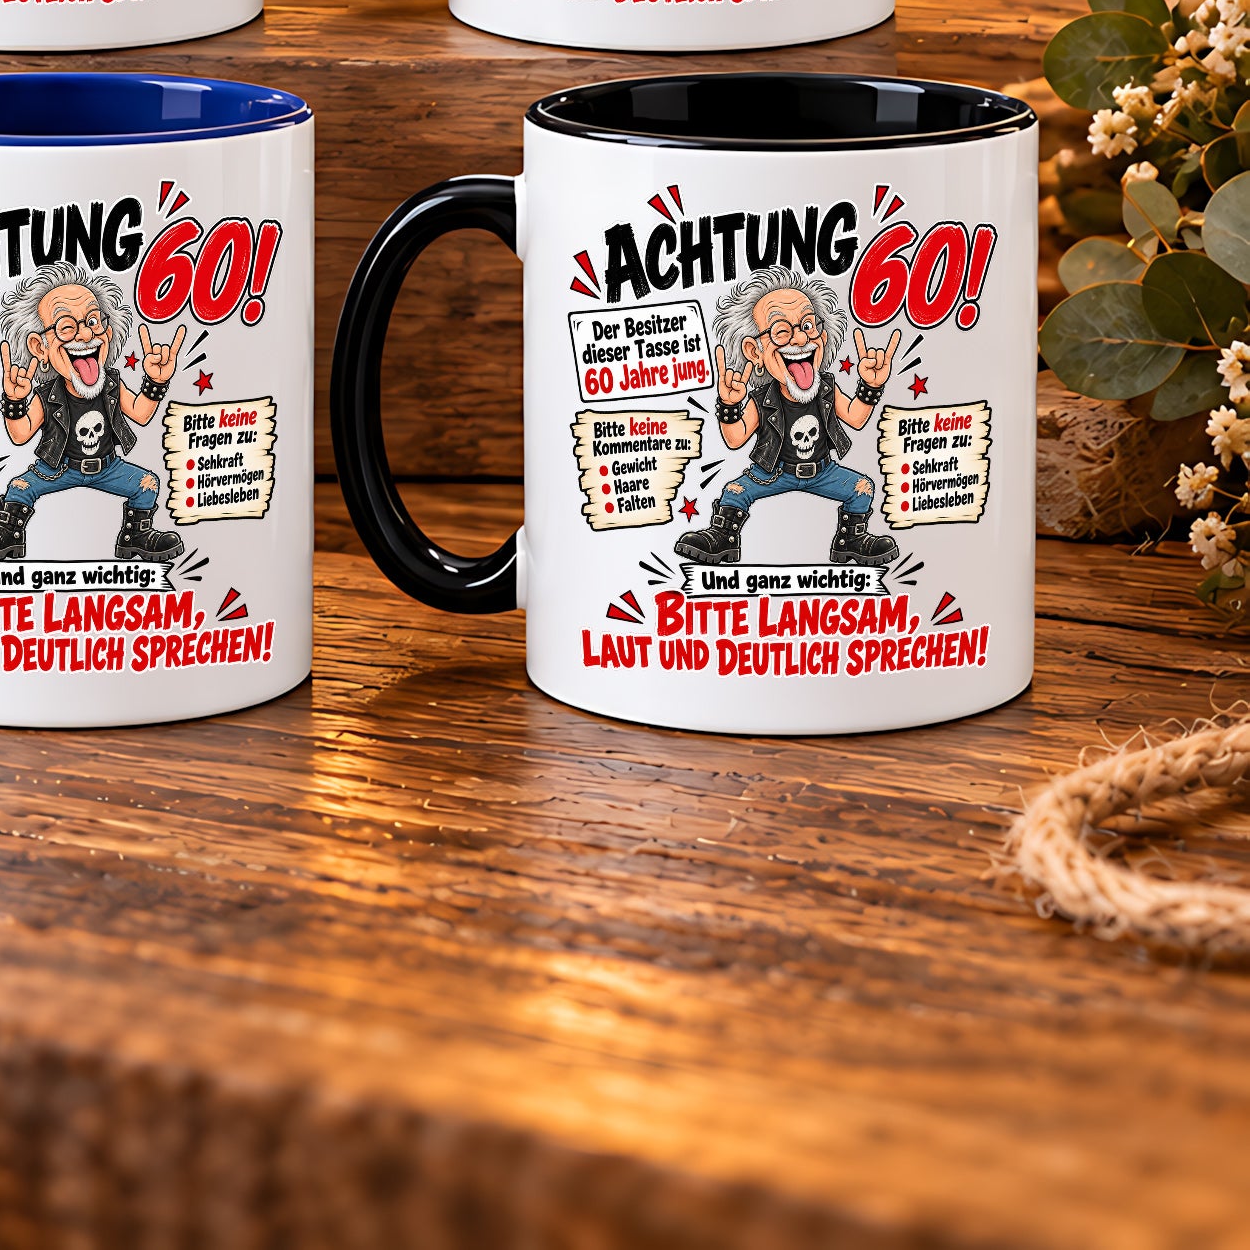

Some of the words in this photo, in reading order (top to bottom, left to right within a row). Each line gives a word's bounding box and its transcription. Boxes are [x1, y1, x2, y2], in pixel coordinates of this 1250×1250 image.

[605, 202, 858, 303] ACHTUNG
[135, 217, 283, 327] 60!
[850, 221, 998, 331] 60!
[592, 320, 620, 341] Der
[624, 314, 687, 338] Besitzer
[584, 367, 614, 395] 60
[619, 361, 669, 391] Jahre
[671, 357, 710, 388] jung.
[183, 413, 215, 432] Bitte
[219, 407, 258, 428] keine
[594, 422, 626, 438] Bitte
[630, 416, 668, 436] keine
[188, 432, 232, 450] Fragen
[237, 430, 258, 444] zu:
[592, 437, 672, 456] Kommentare
[675, 438, 692, 450] zu:
[198, 452, 244, 471] Sehkraft
[612, 456, 658, 476] Gewicht
[198, 469, 264, 489] Hörvermögen
[614, 478, 650, 495] Haare
[198, 487, 259, 508] Liebesleben
[616, 496, 656, 514] Falten
[31, 570, 76, 588] ganz
[82, 565, 156, 588] wichtig:
[702, 570, 739, 590] Und
[746, 574, 791, 592] ganz
[797, 570, 871, 592] wichtig:
[44, 591, 205, 633] LANGSAM,
[654, 590, 749, 636] BITTE
[758, 595, 920, 638] LANGSAM,
[1, 634, 124, 672] DEUTLICH
[131, 621, 275, 672] SPRECHEN!
[582, 630, 652, 668] LAUT
[659, 639, 710, 670] UND
[716, 638, 839, 676] DEUTLICH
[846, 626, 990, 676] SPRECHEN!
